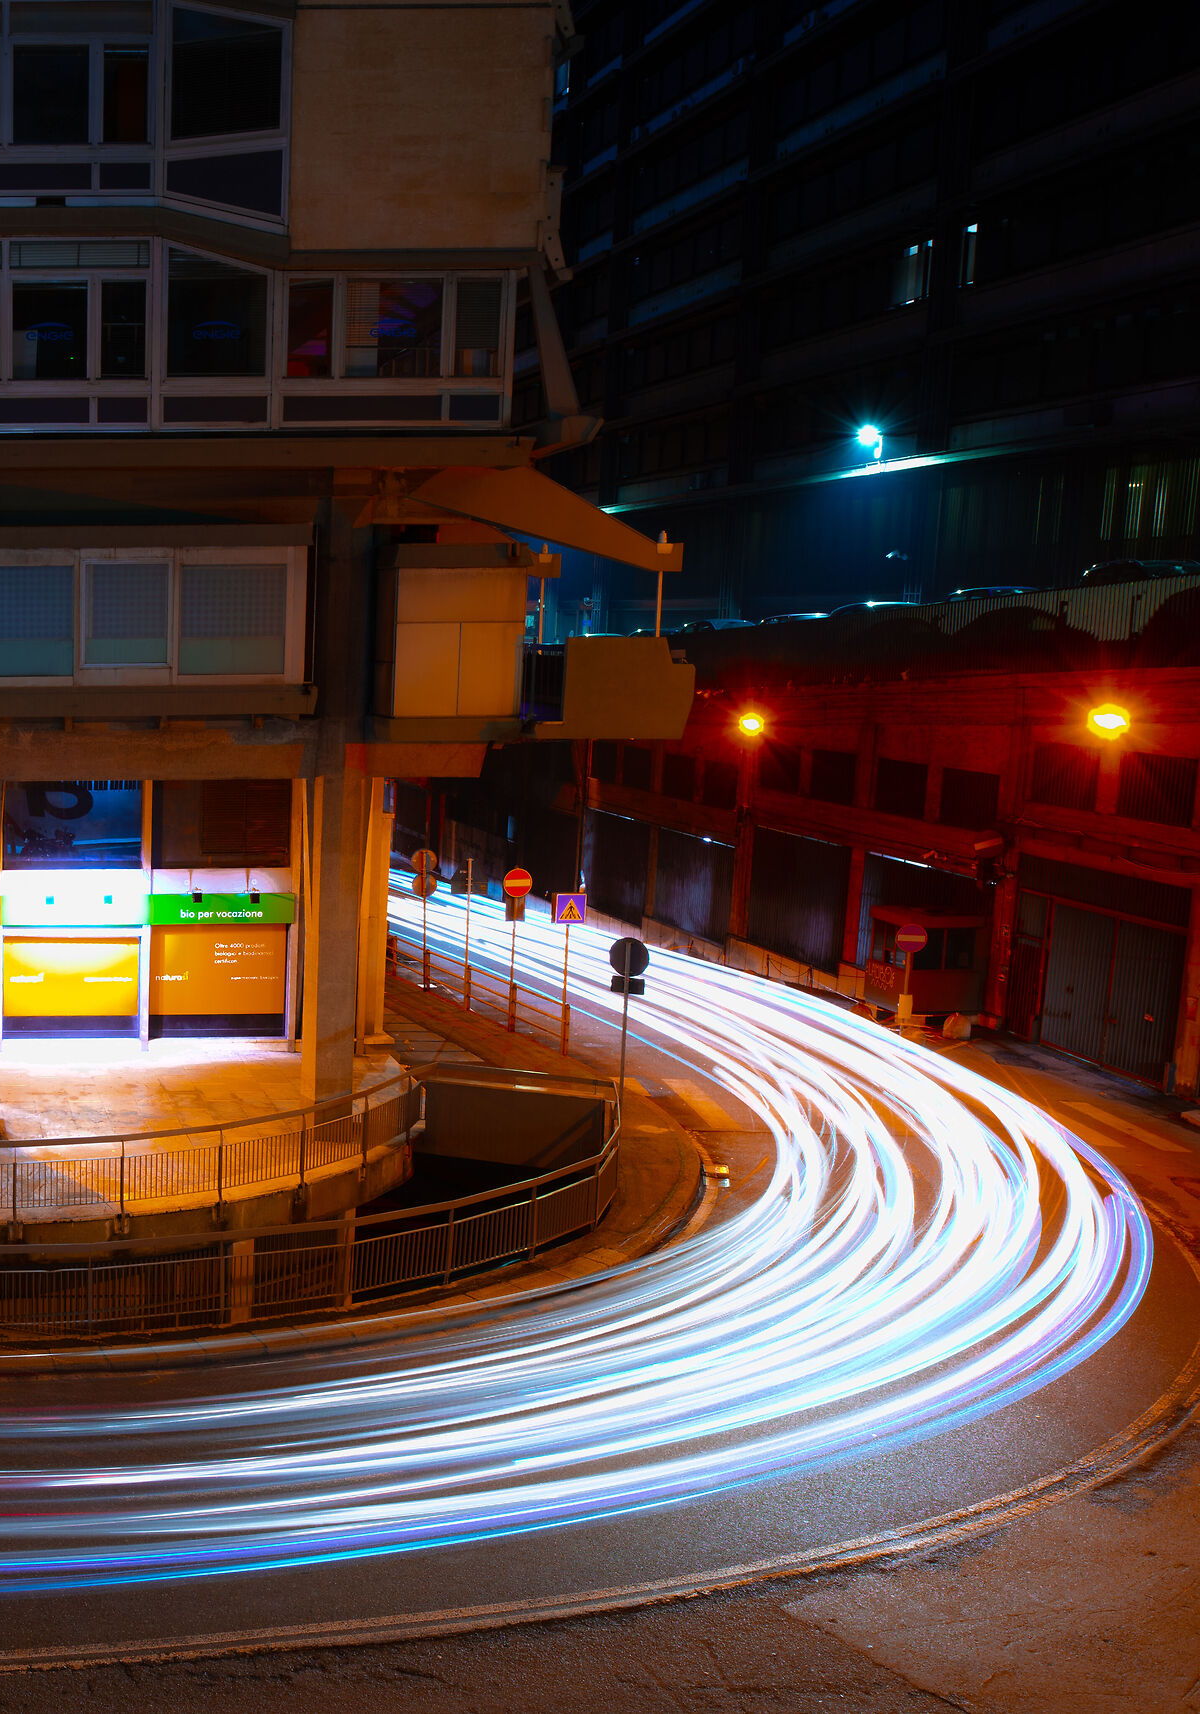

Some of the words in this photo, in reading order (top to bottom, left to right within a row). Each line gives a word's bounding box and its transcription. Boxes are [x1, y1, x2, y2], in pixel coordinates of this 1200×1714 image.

[180, 909, 196, 918] bio
[198, 910, 214, 920] per
[216, 908, 264, 918] vocazione
